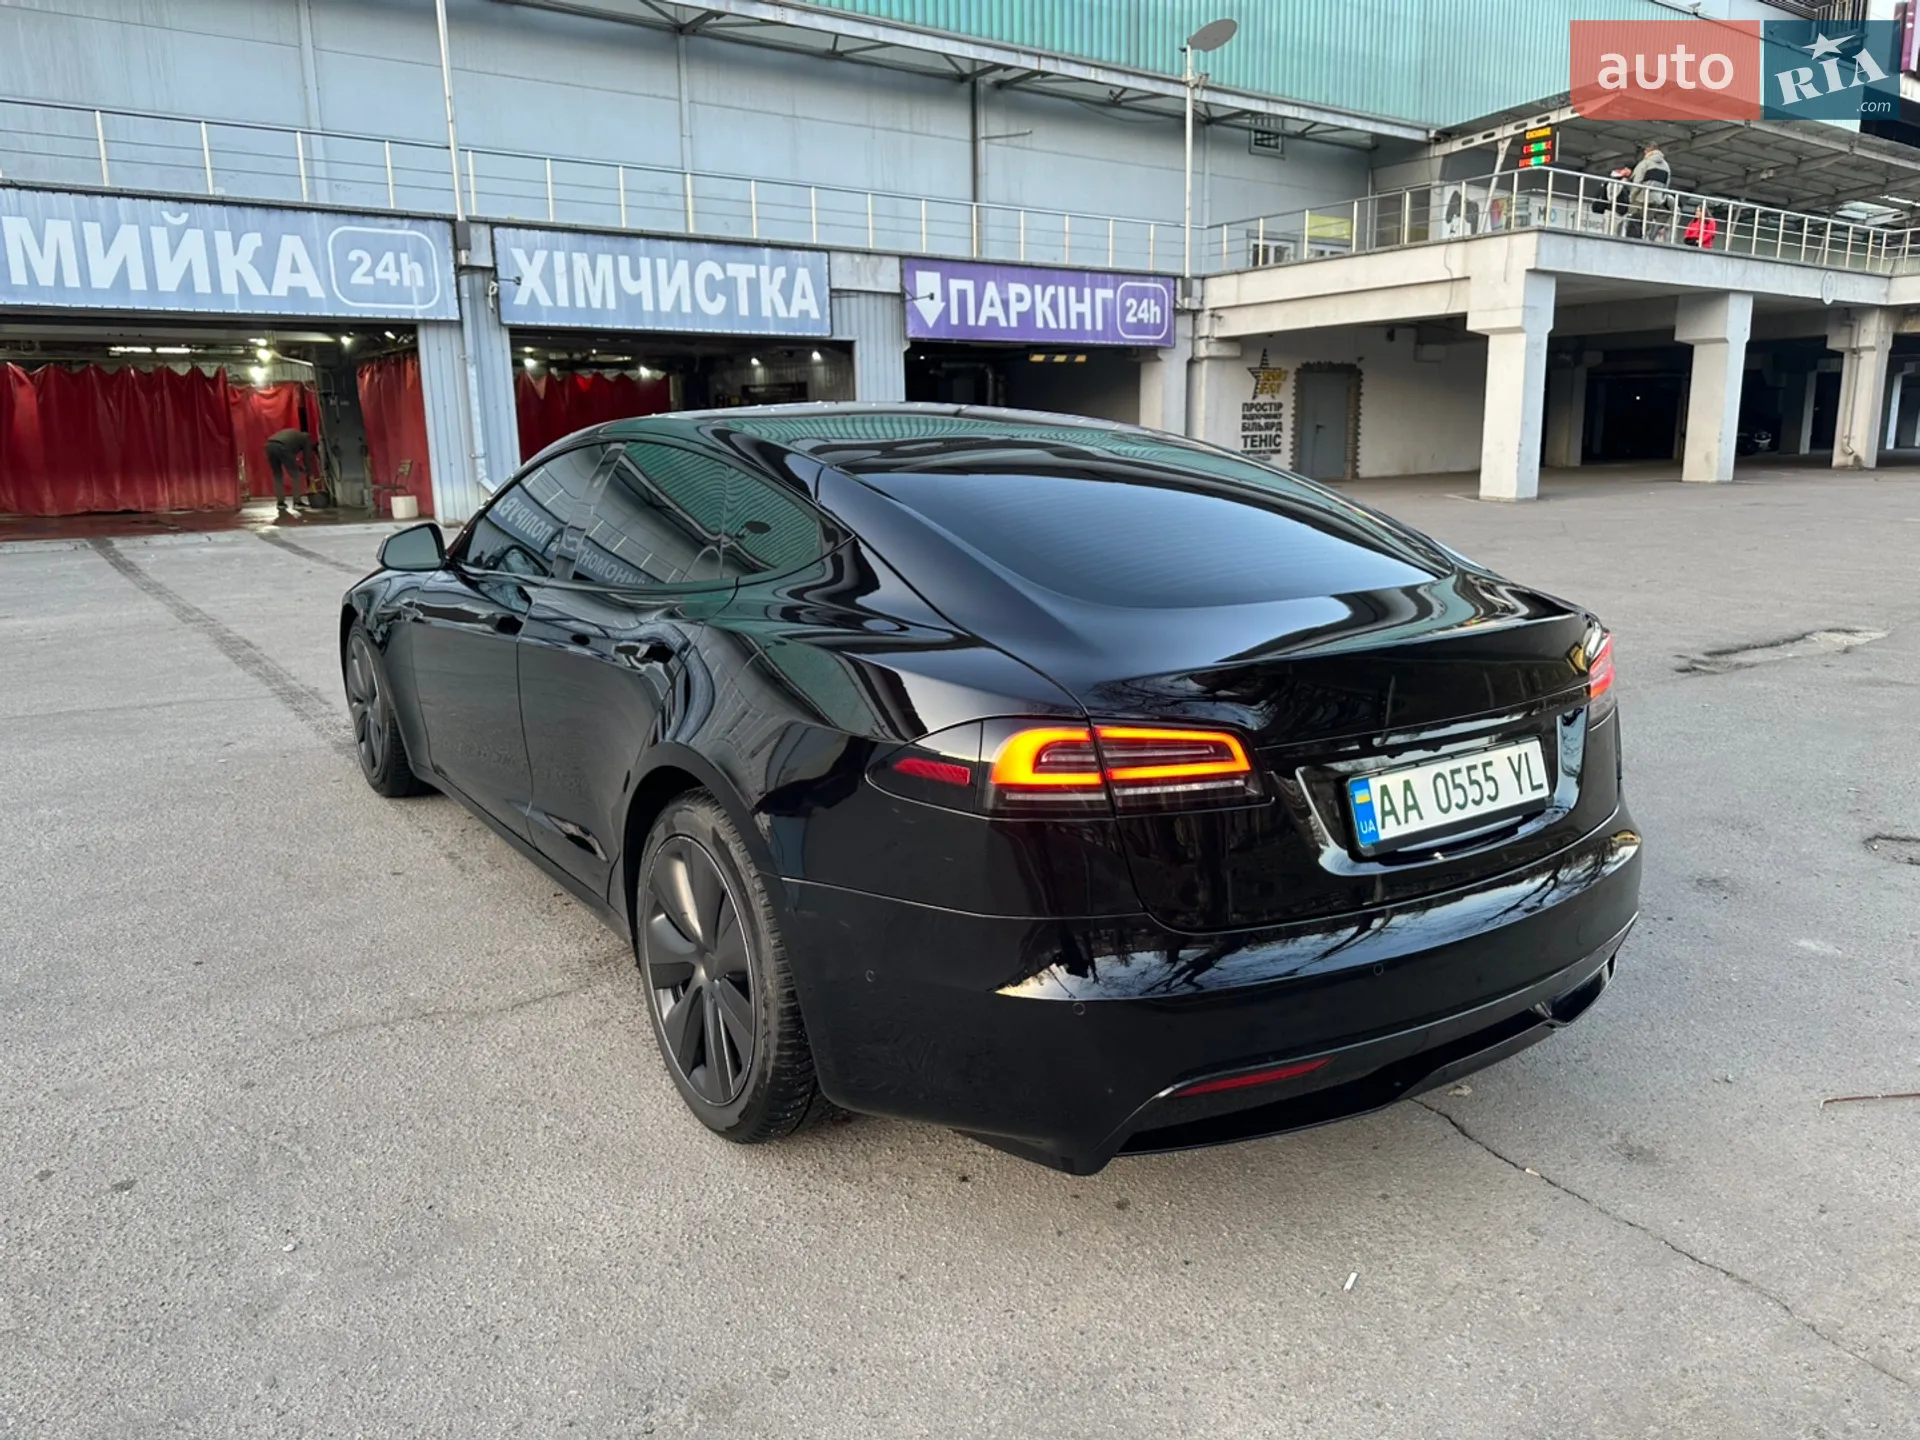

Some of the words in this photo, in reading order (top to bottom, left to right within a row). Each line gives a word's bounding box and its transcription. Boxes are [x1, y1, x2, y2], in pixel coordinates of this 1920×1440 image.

[1, 211, 325, 298] МИЙКА
[347, 249, 424, 288] 24h
[511, 248, 820, 320] ХІМЧИСТКА
[948, 278, 1114, 331] ПАРКІНГ
[1125, 298, 1162, 325] 24h
[1242, 402, 1283, 412] ПРОСТІР
[1241, 421, 1283, 432] БІЛЬЯРД
[1241, 434, 1282, 448] ТЕНІС
[1379, 779, 1424, 830] AA
[1433, 761, 1499, 814] 0555
[1507, 752, 1544, 795] YL
[1360, 821, 1376, 834] UA
